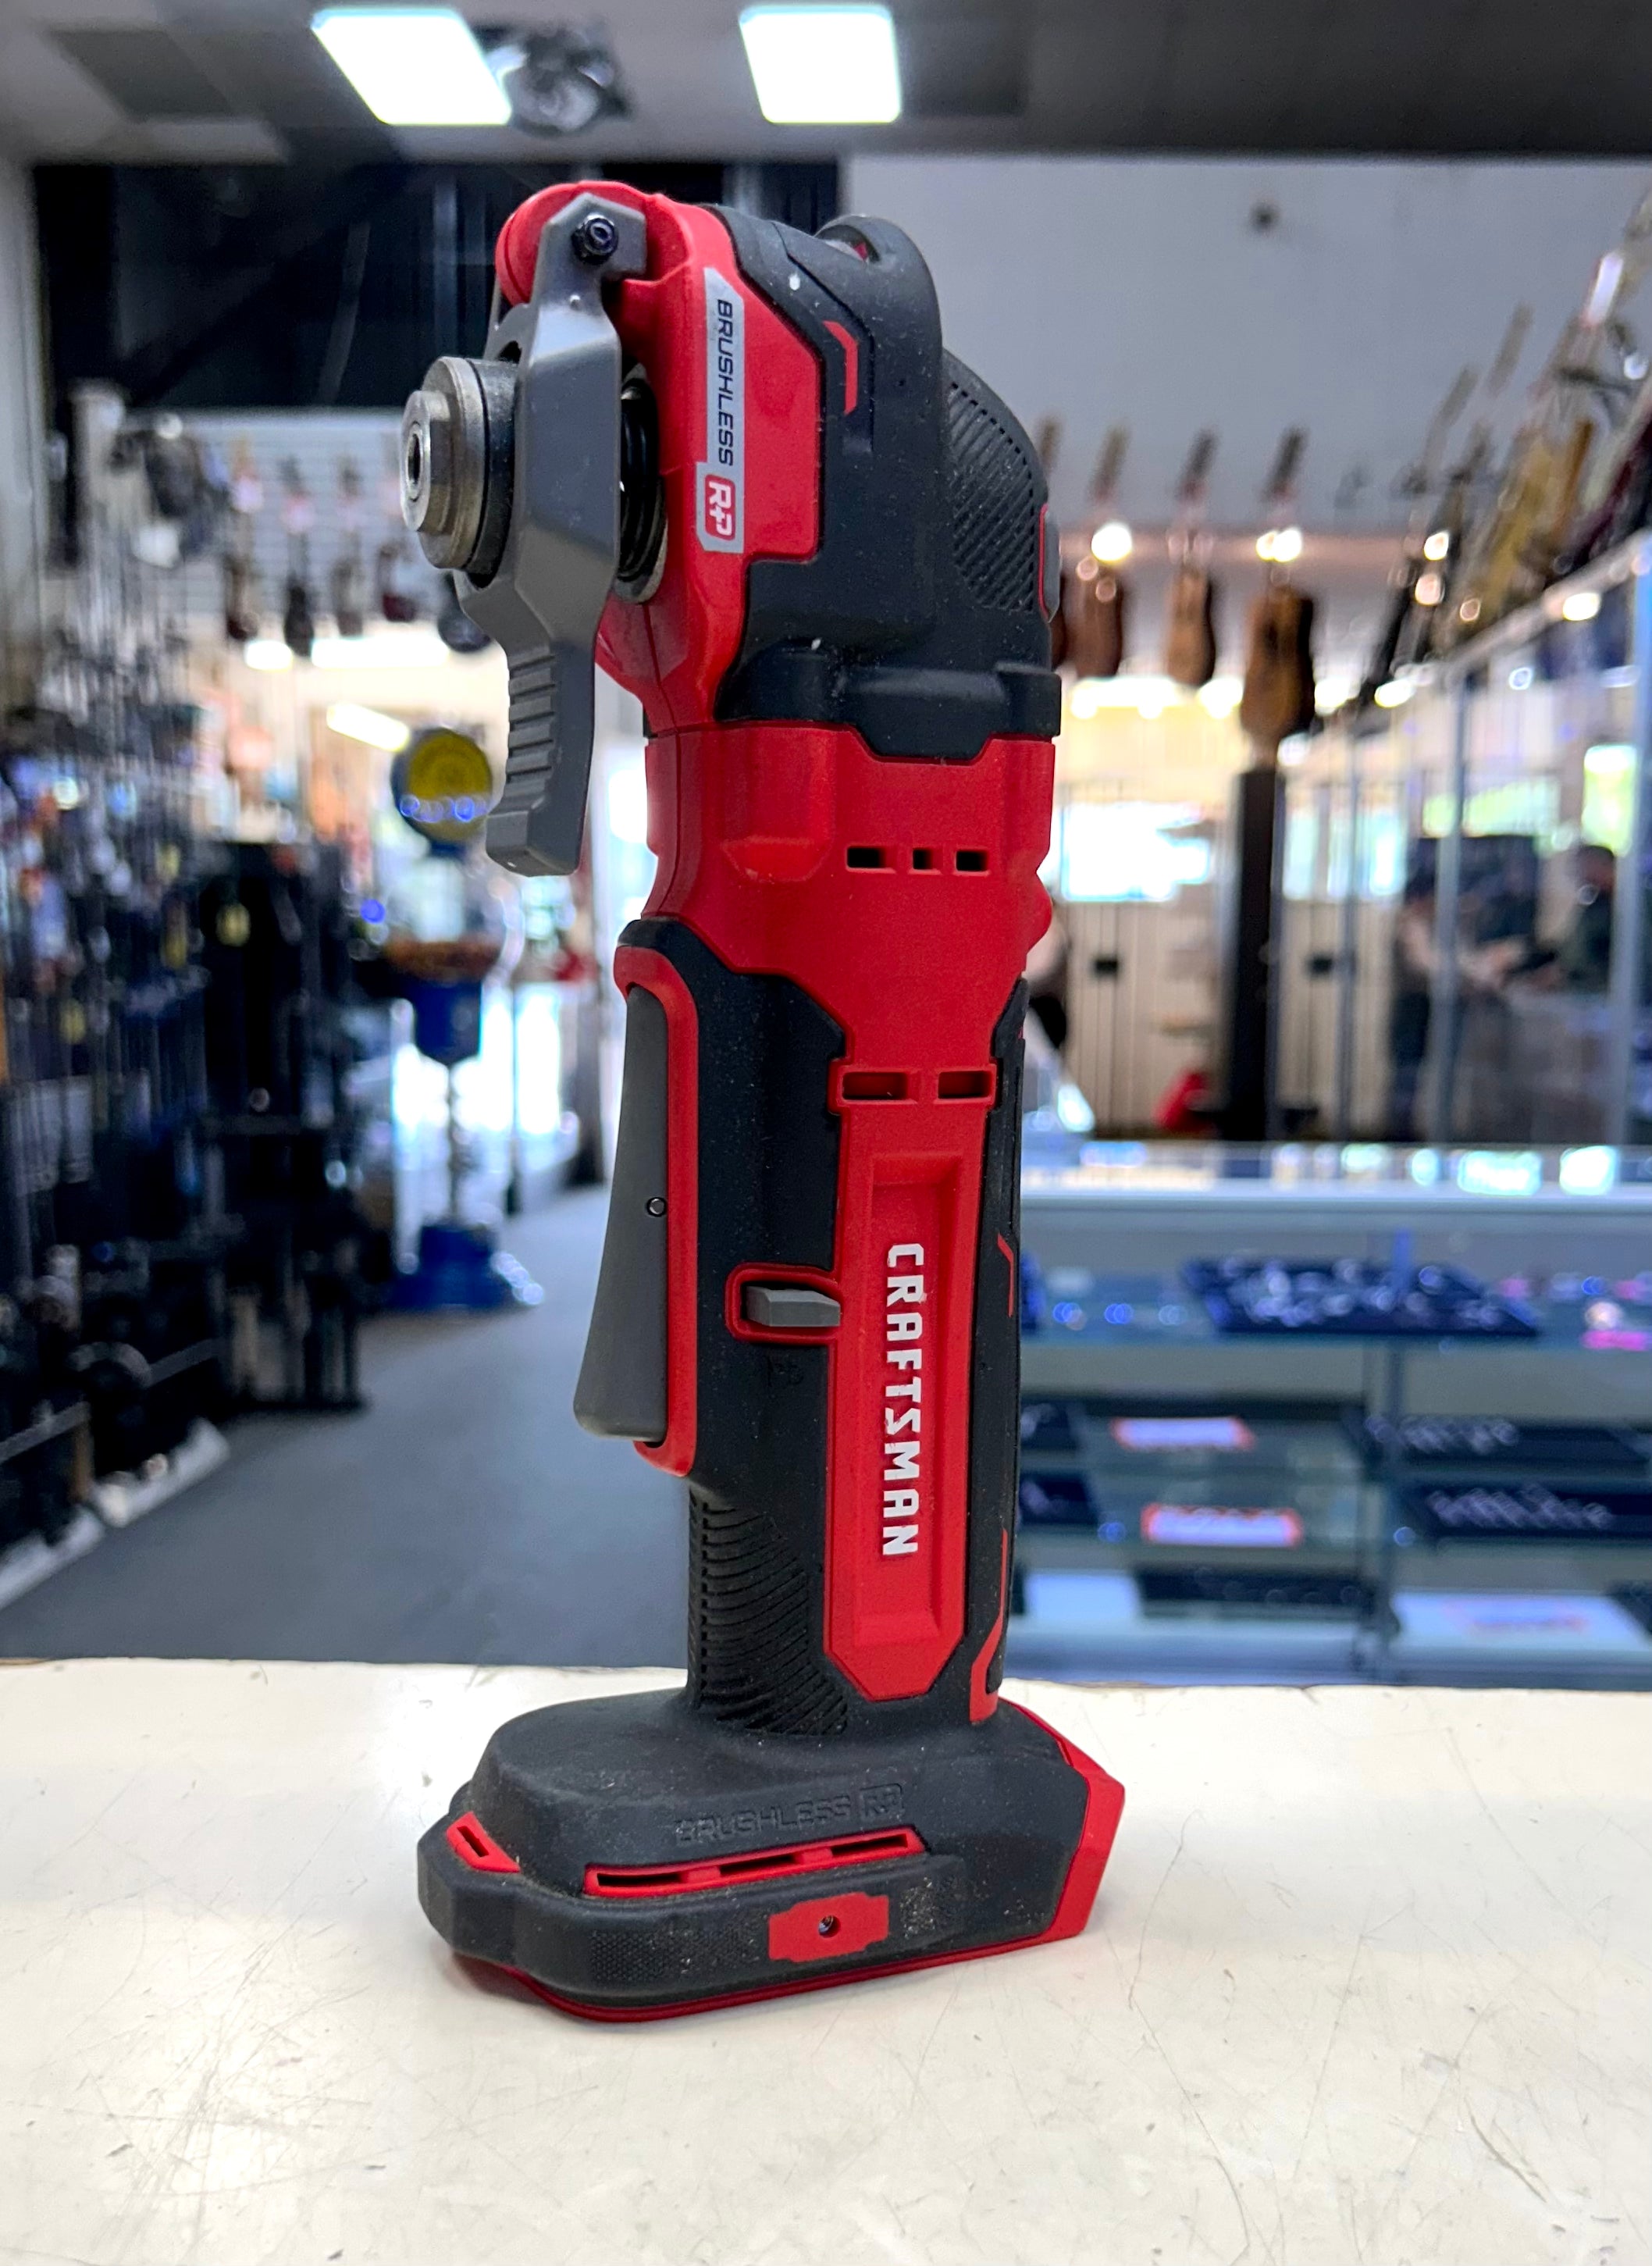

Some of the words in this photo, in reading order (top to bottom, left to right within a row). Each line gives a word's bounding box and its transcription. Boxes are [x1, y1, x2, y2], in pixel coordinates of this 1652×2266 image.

[717, 299, 733, 466] BRUSHLESS
[882, 1243, 924, 1556] CRAFTSMAN
[674, 1795, 851, 1843] BRUSHLESS
